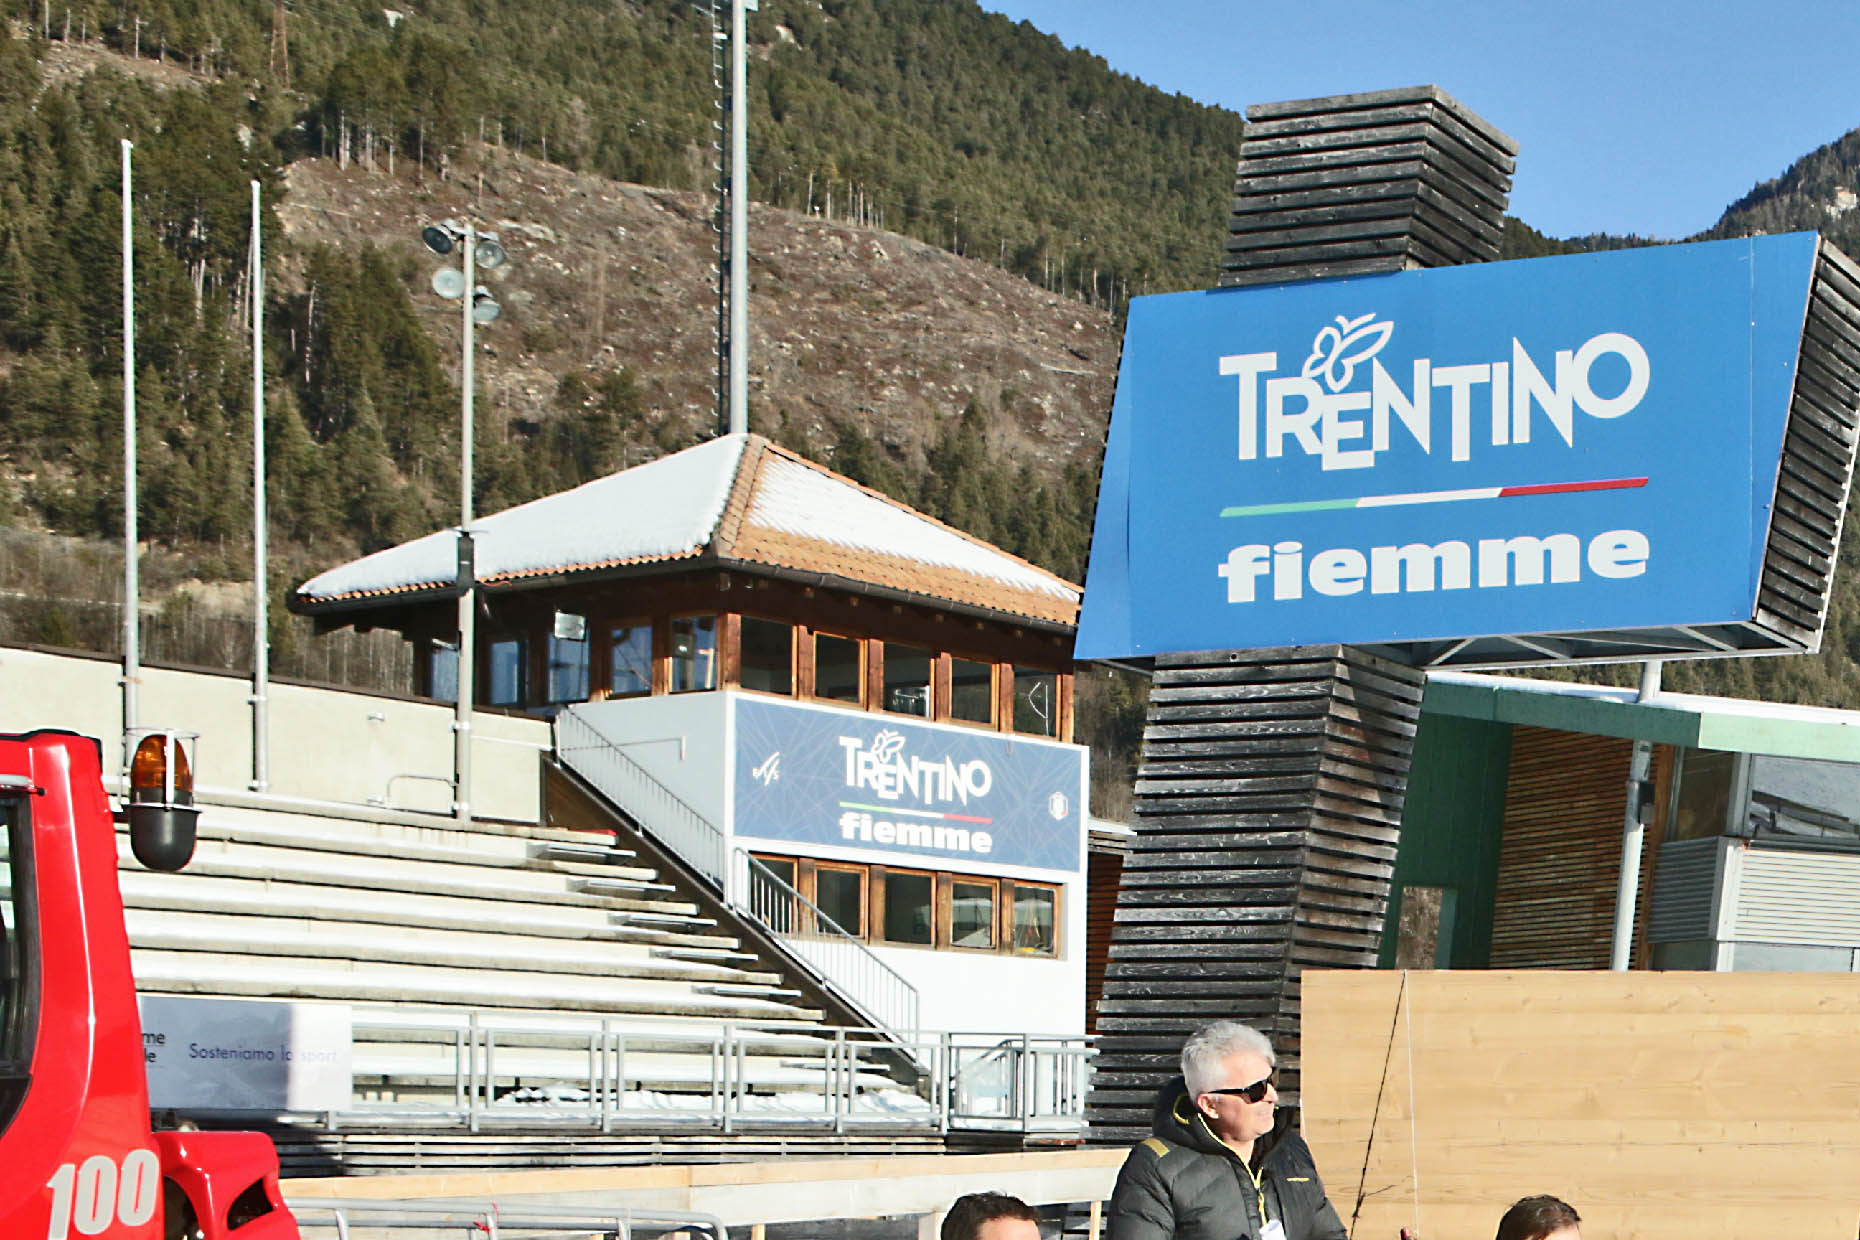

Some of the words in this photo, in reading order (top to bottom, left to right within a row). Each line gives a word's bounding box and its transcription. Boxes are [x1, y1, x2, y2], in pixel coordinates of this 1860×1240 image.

[1219, 333, 1650, 471] TRENTINO
[1218, 529, 1650, 603] fiemme
[839, 736, 993, 806] TRENTINO
[839, 811, 993, 853] fiemme
[189, 1042, 275, 1061] Sosteniamo
